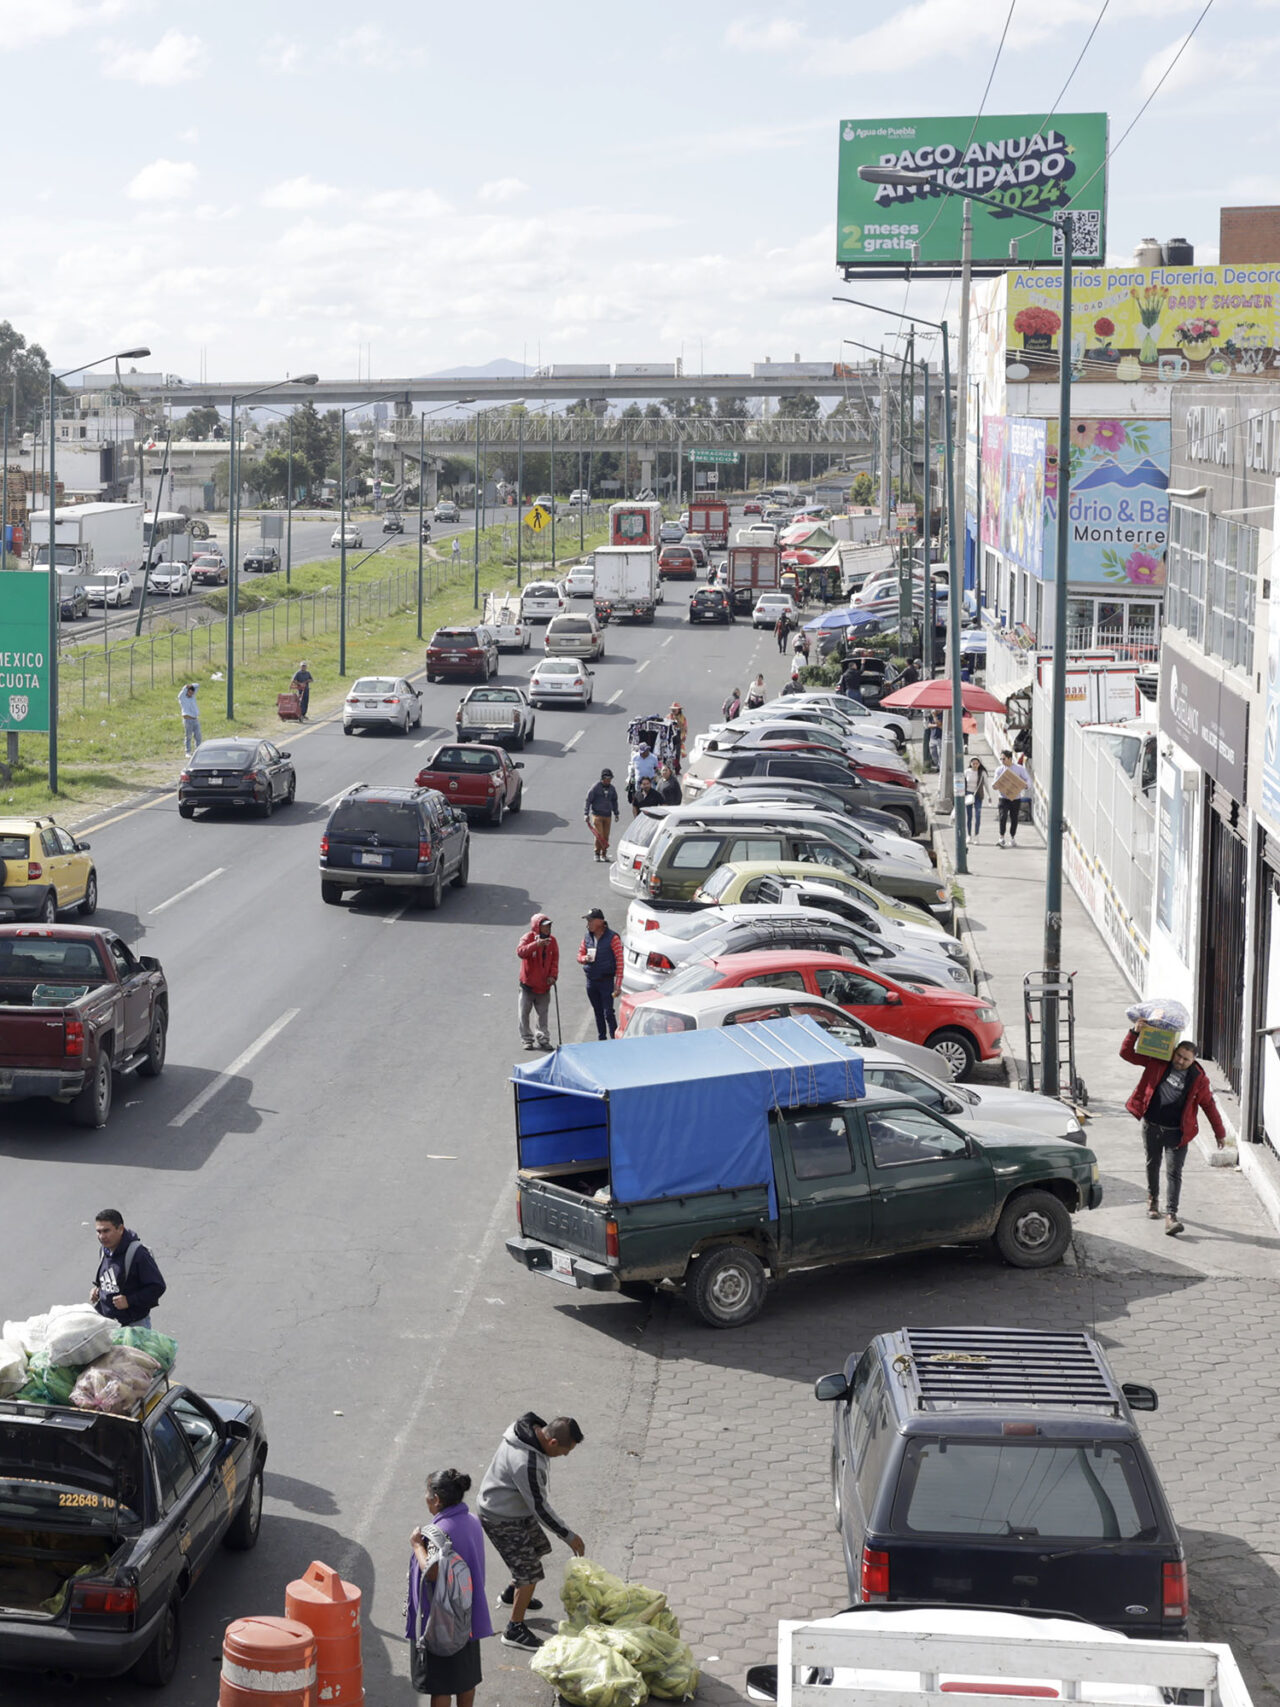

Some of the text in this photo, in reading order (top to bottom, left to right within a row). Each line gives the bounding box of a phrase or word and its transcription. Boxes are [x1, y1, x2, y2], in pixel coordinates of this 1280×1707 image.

[856, 127, 915, 138] Agua de Puebla
[879, 130, 1064, 170] PAGO ANUAL
[874, 153, 1066, 201] ANTICIPADO
[985, 179, 1061, 213] 2024
[842, 225, 862, 249] 2
[864, 224, 919, 235] meses
[864, 235, 914, 252] gratis
[1014, 271, 1102, 289] Accesrios
[1108, 274, 1145, 291] para
[1168, 294, 1273, 310] BABY SHOWER
[1045, 497, 1112, 523] Vdrio
[1120, 500, 1136, 523] &
[1074, 526, 1167, 544] Monterre
[11, 704, 27, 715] 150
[527, 1201, 595, 1238] NISSAN
[59, 1494, 98, 1508] 222648
